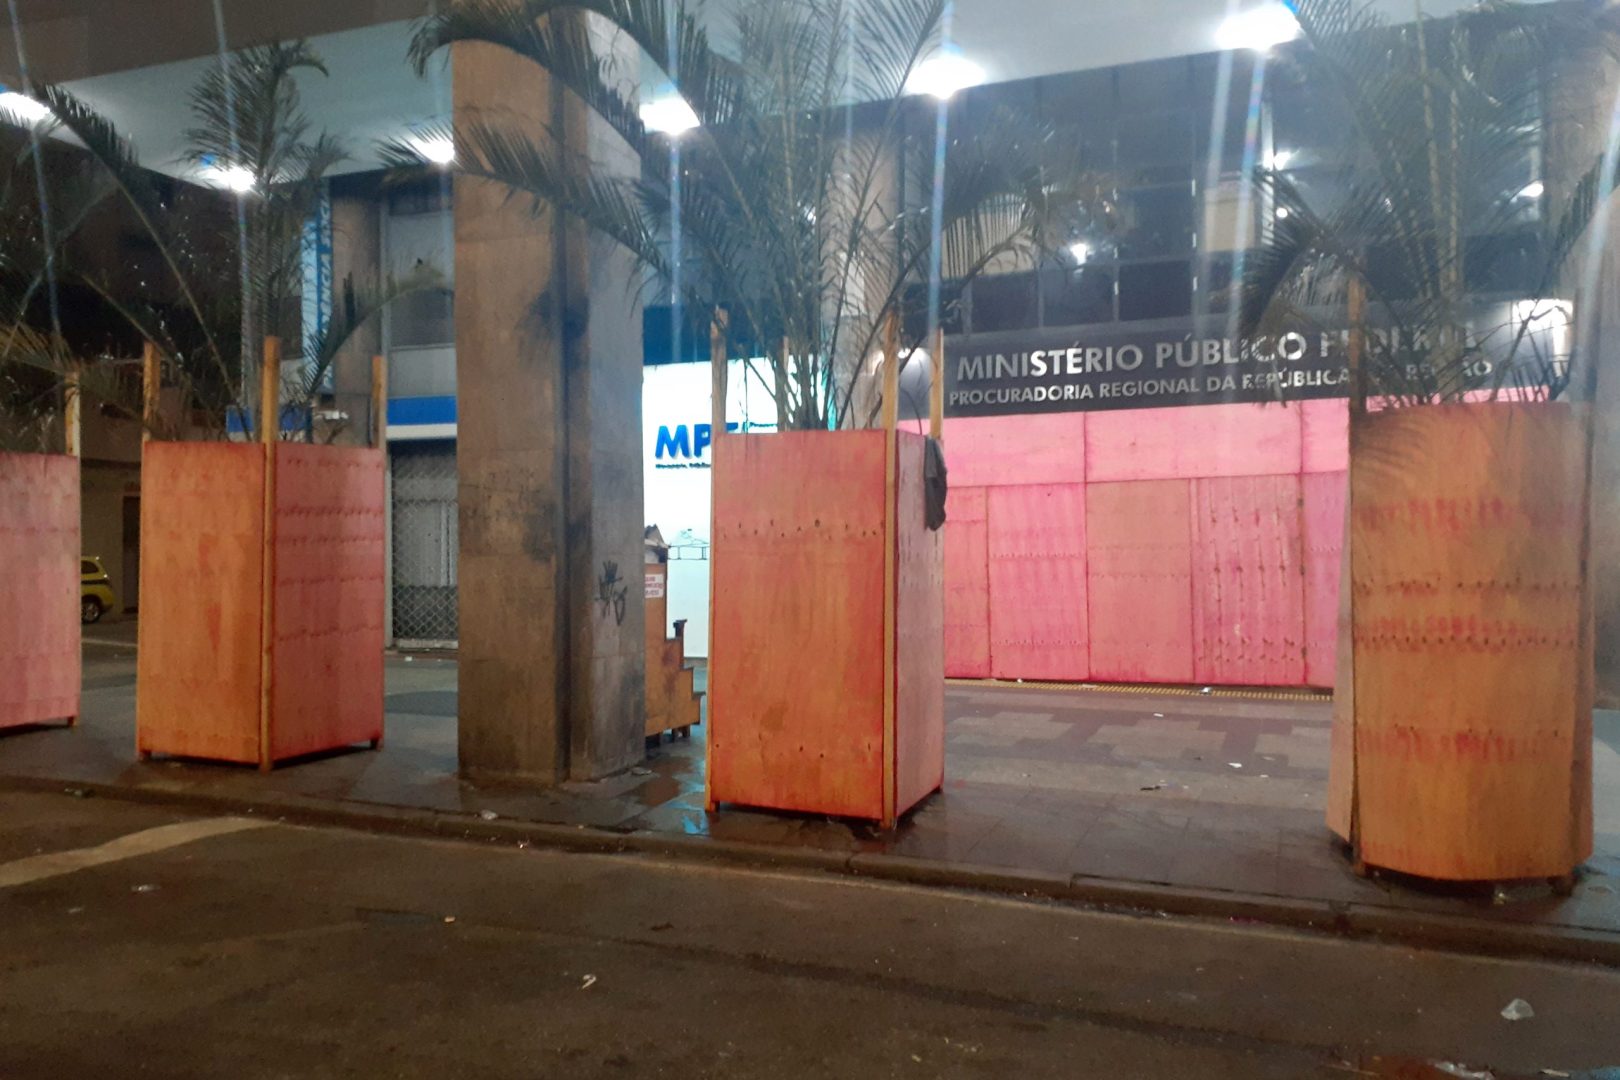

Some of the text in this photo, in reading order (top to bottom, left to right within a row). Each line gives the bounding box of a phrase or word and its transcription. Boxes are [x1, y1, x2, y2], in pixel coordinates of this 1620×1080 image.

[956, 341, 1143, 381] MINISTÉRIO
[1155, 332, 1307, 368] PÚBLICO
[950, 383, 1093, 406] PROCURADORIA
[1100, 377, 1199, 398] REGIONAL
[1206, 374, 1236, 391] DA
[1242, 366, 1350, 390] REPÚBLICA
[655, 422, 738, 459] MP
